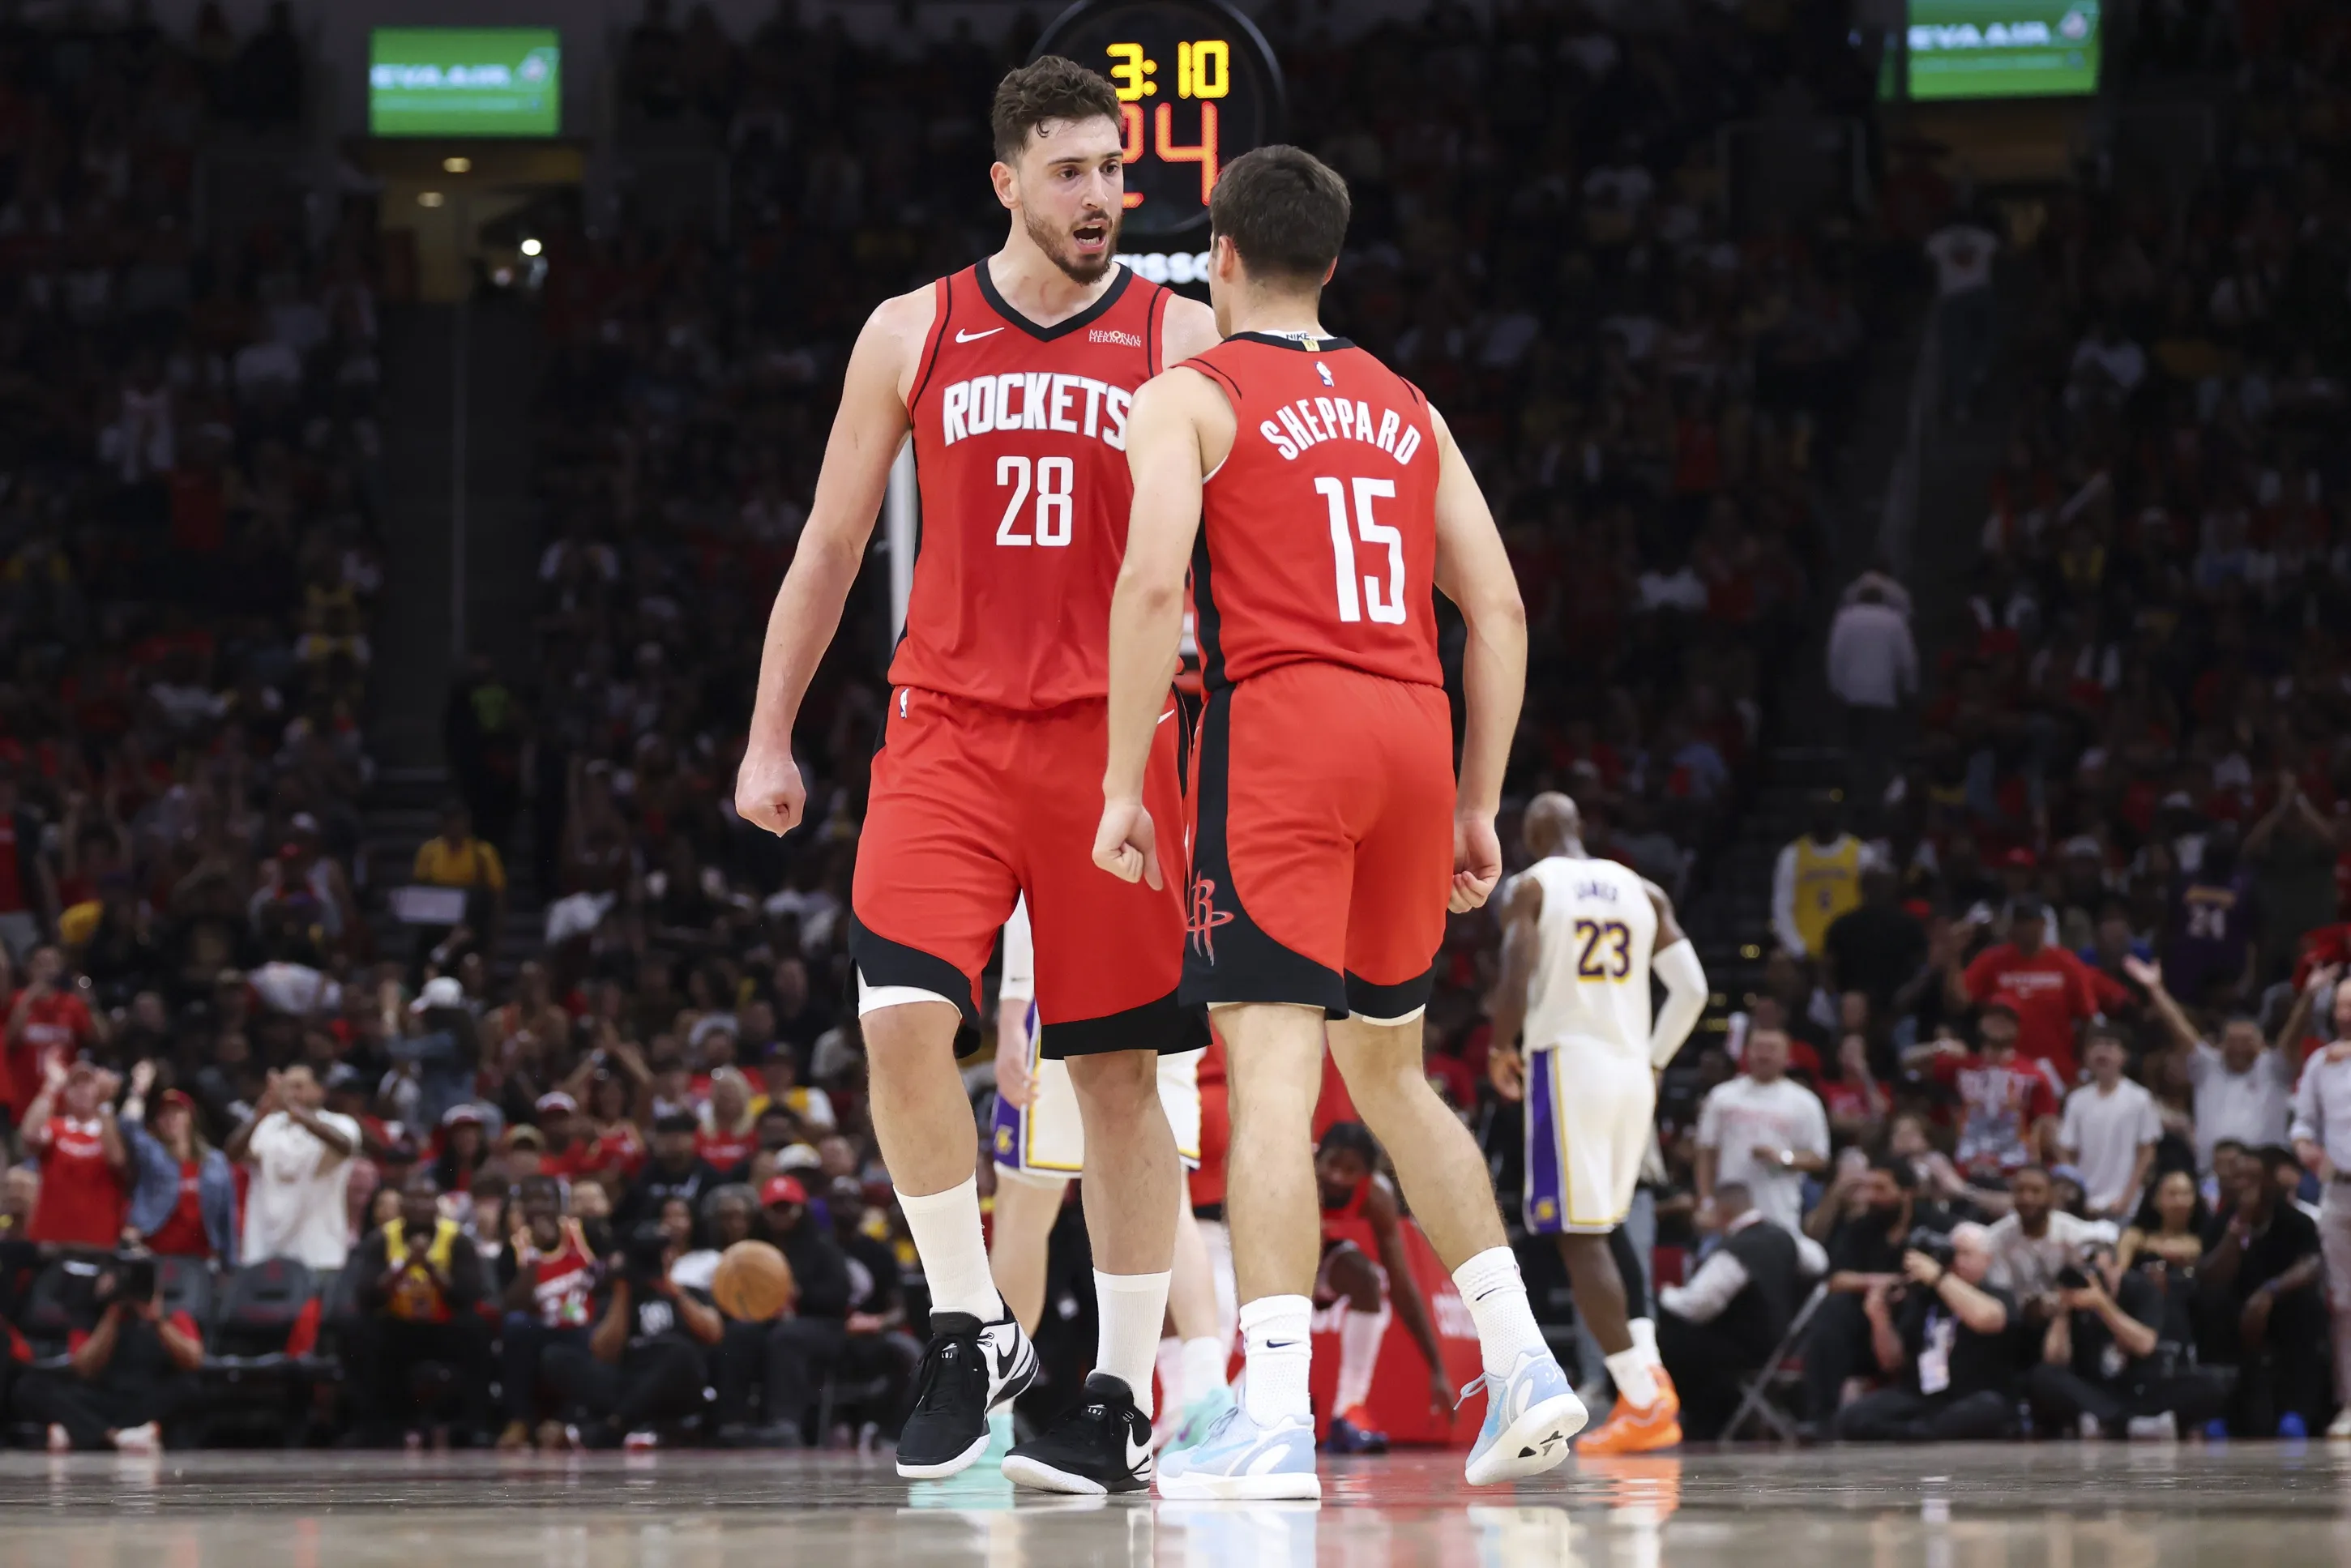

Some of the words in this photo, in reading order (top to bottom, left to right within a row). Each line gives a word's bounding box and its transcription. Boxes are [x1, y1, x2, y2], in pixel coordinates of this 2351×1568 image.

[1106, 40, 1229, 101] 3:10
[1088, 334, 1142, 348] HERMANN
[1089, 329, 1141, 342] MEMORIAL
[1285, 332, 1310, 341] NIKE
[943, 372, 1135, 452] ROCKETS
[1259, 397, 1421, 465] SHEPPARD
[995, 455, 1074, 547] 28
[1314, 476, 1407, 625] 15
[1575, 919, 1631, 983] 23
